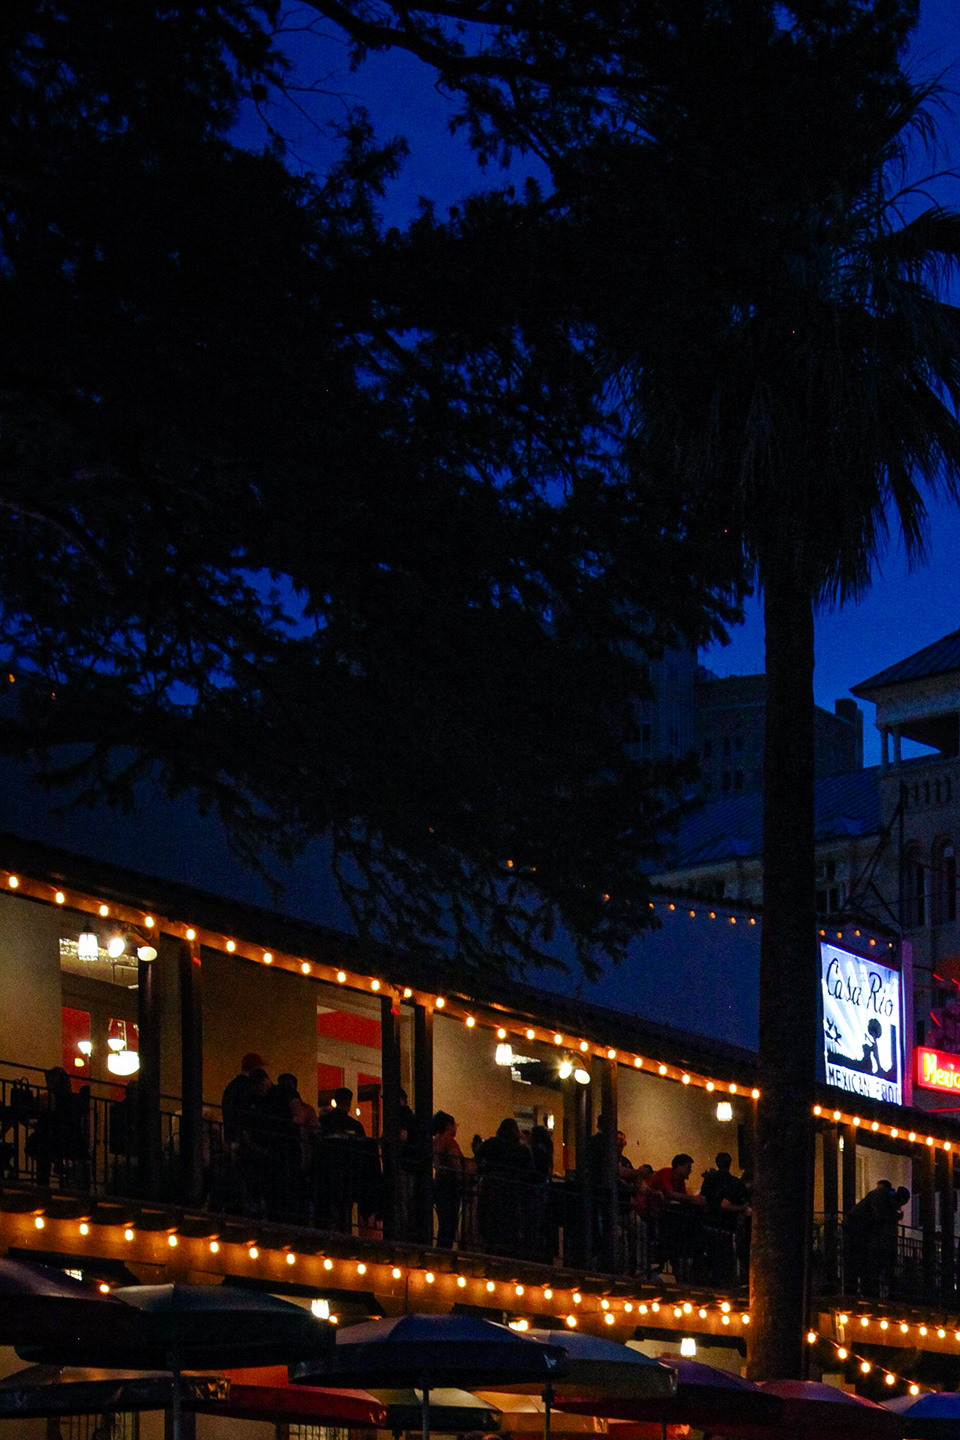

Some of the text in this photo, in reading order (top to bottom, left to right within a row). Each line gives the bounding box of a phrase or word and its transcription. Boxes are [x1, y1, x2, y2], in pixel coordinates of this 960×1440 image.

[826, 958, 893, 1016] Casa Rio
[828, 1065, 871, 1098] MEXICAN
